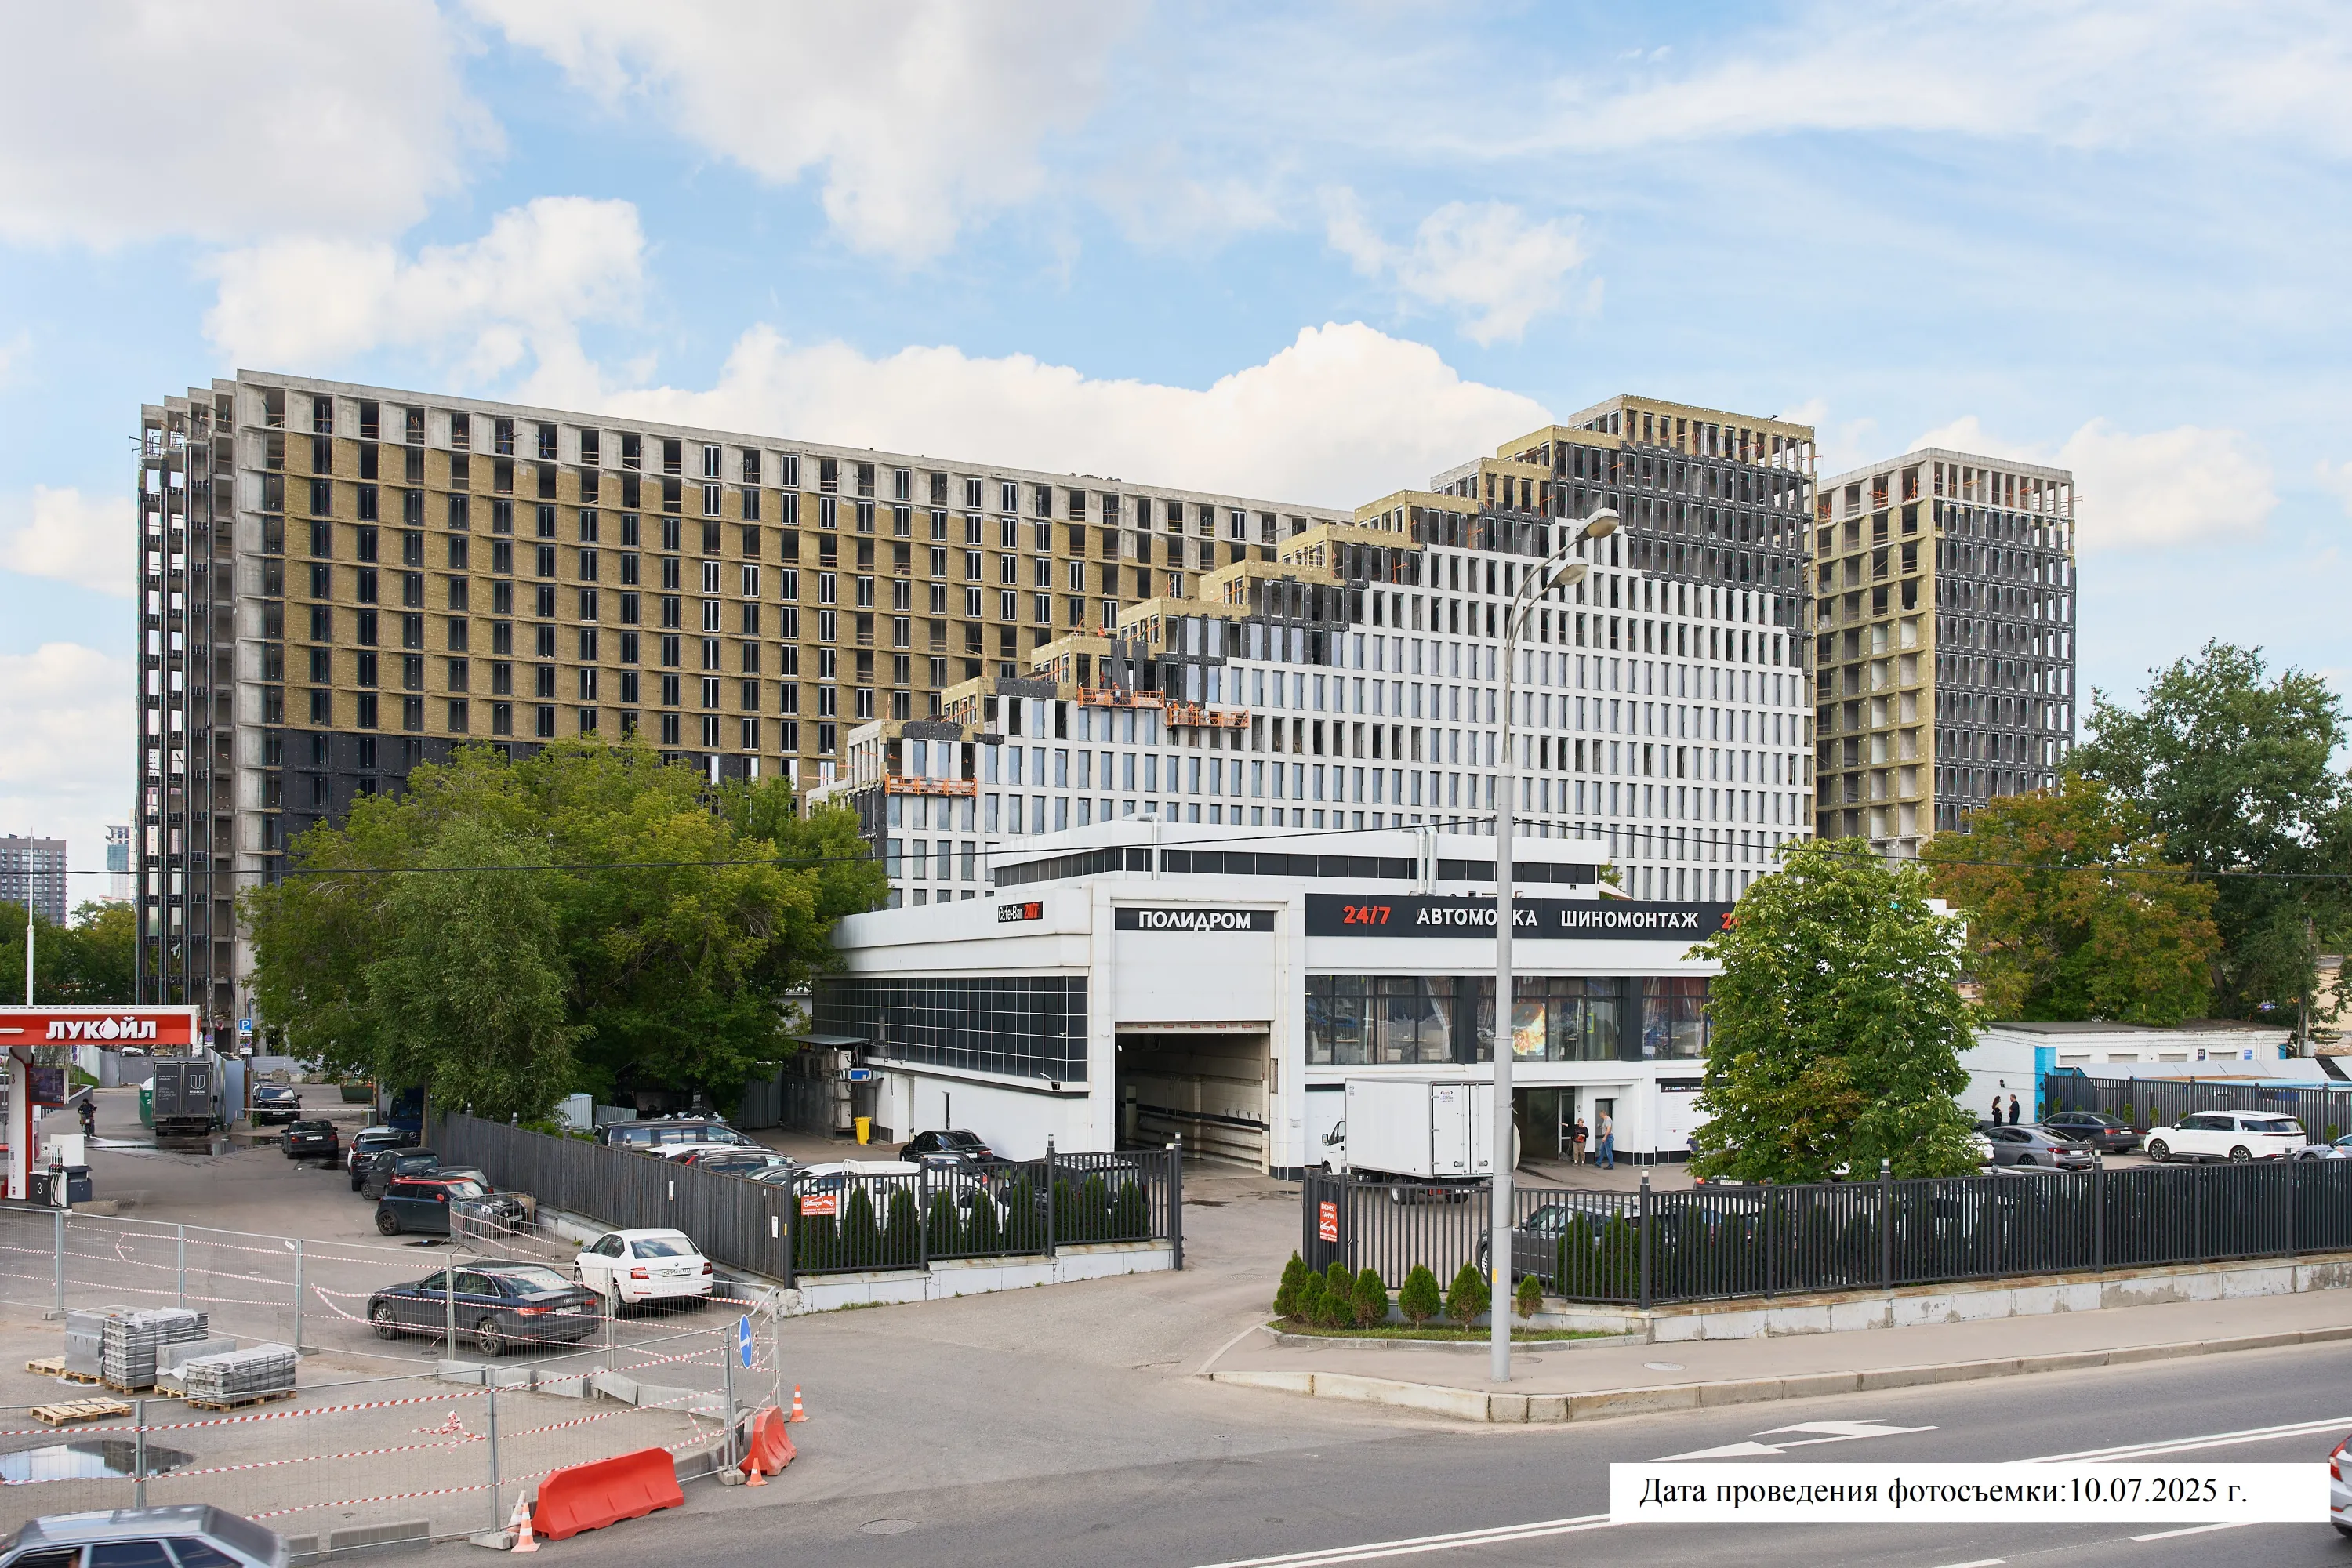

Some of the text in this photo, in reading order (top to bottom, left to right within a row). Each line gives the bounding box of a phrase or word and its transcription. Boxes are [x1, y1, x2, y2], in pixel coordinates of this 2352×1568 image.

[998, 906, 1023, 921] Cafe-Bar
[1138, 911, 1251, 931] ПОЛИДРОМ
[1343, 906, 1391, 925] 24/7
[1417, 908, 1538, 927] АВТОМОКА
[1561, 910, 1699, 928] ШИНОМОНТАЖ
[45, 1015, 157, 1040] ЛУКОЙЛ
[11, 1073, 16, 1084] 3
[38, 1182, 42, 1194] 3
